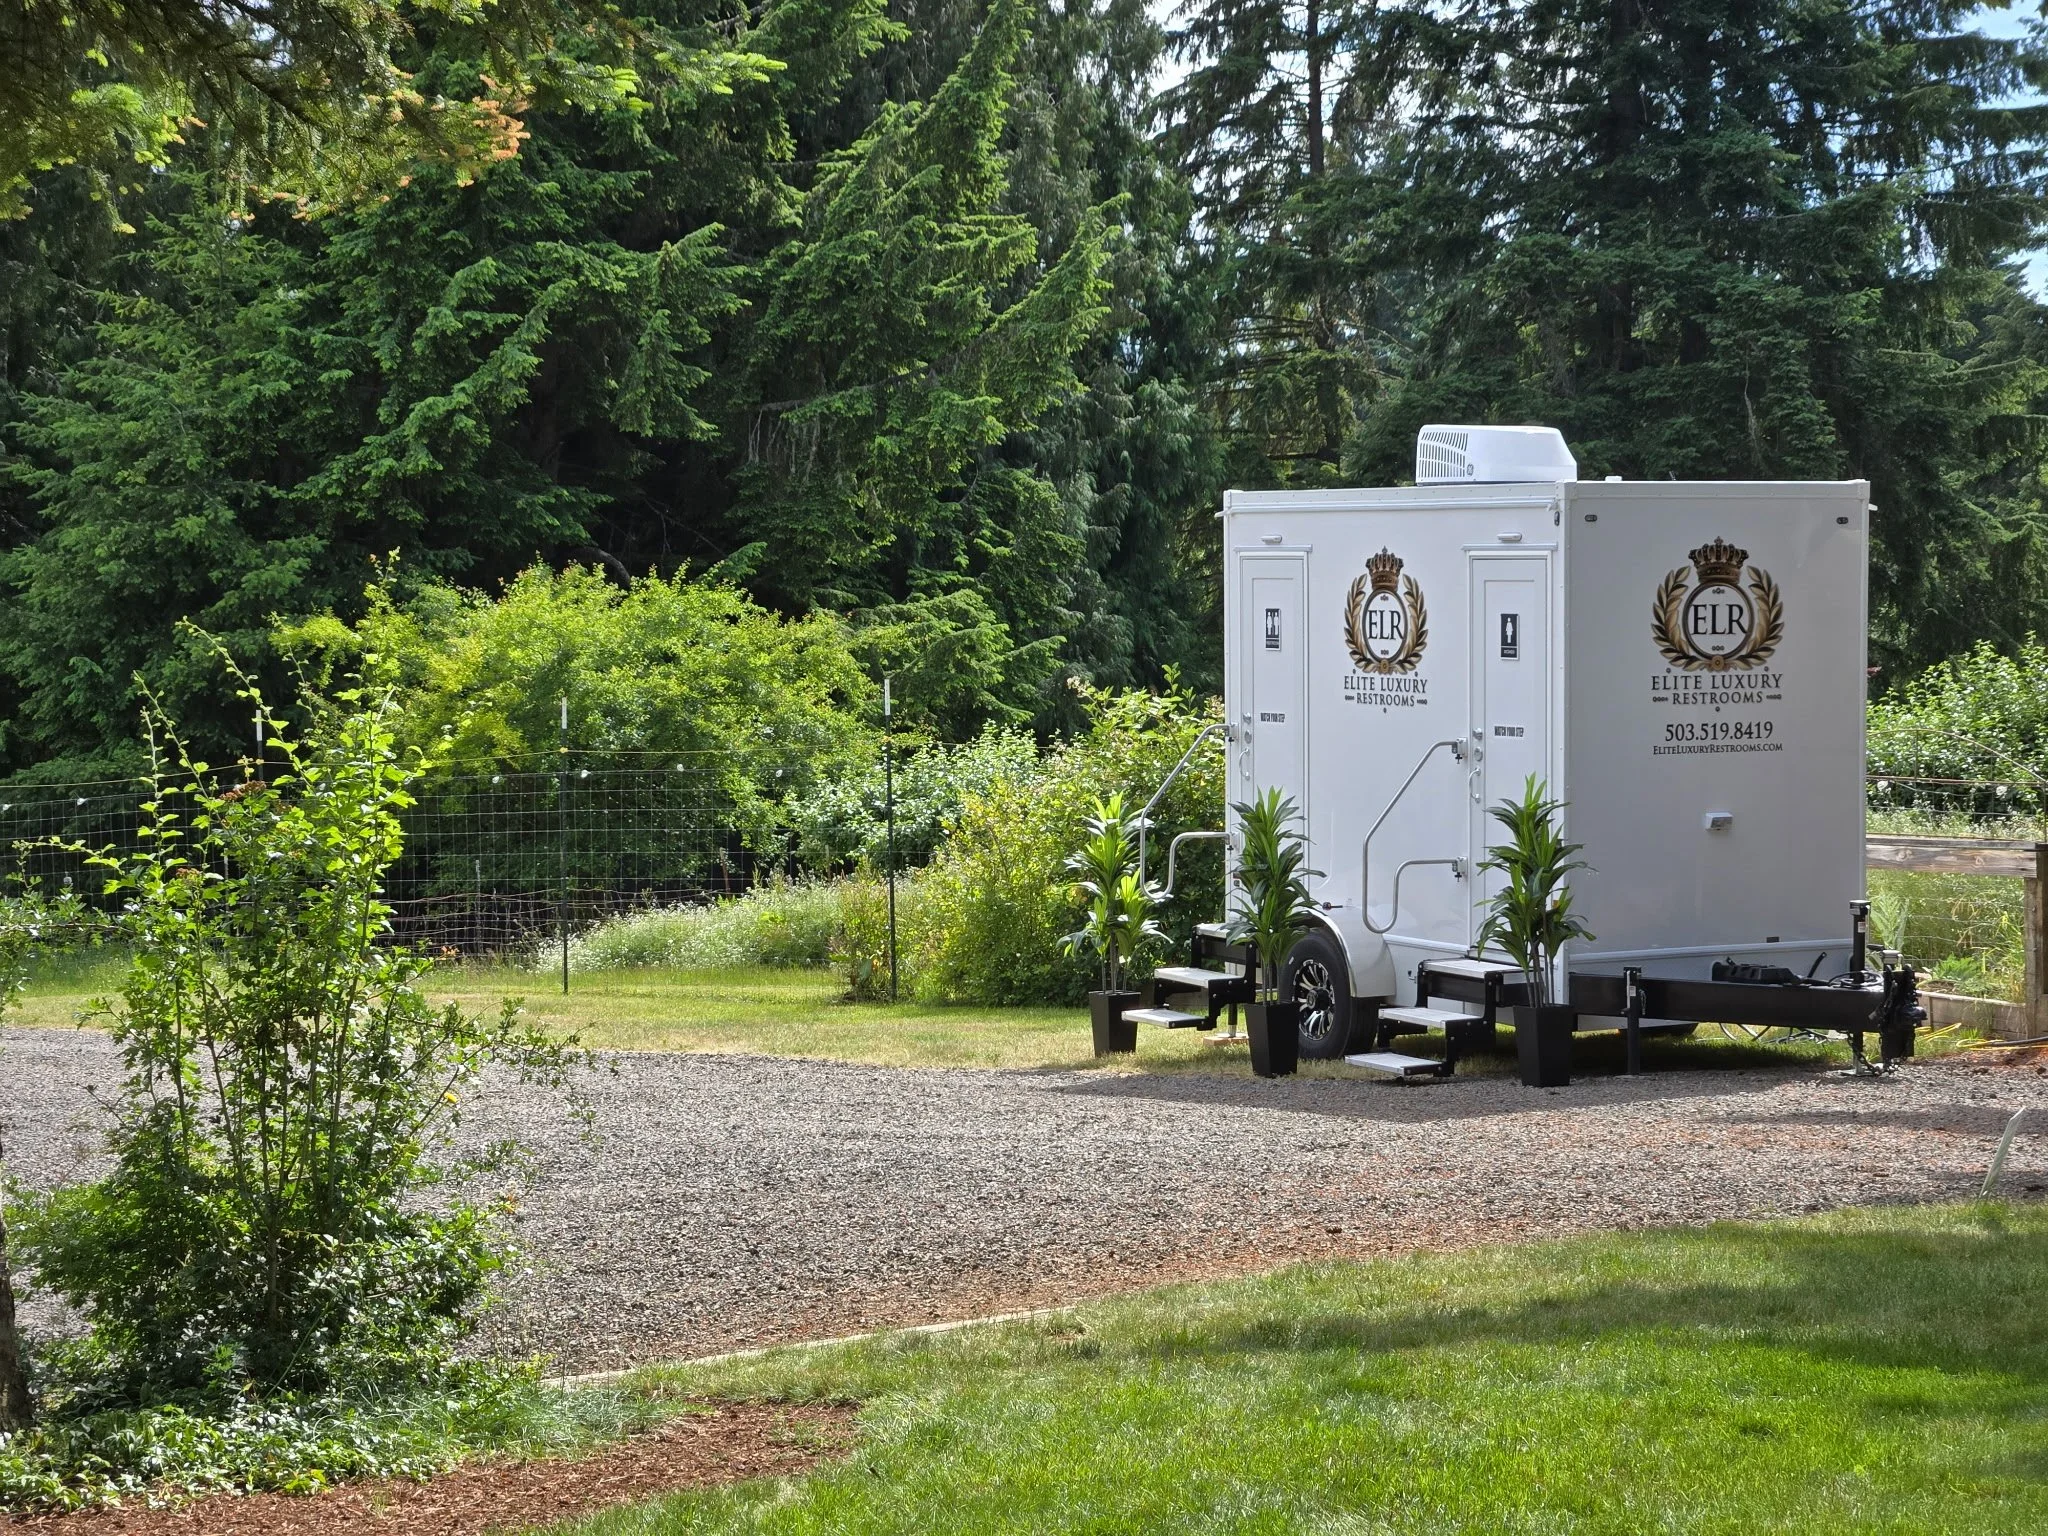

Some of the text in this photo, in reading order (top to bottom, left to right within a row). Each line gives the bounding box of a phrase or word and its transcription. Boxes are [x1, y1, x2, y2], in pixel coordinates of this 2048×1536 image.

[1368, 610, 1405, 640] ELR
[1691, 603, 1748, 635] ELR
[1344, 676, 1428, 693] ELITE LUXURY
[1651, 674, 1783, 691] ELITE LUXURY
[1356, 692, 1415, 707] RESTROOMS
[1672, 691, 1763, 705] RESTROOMS
[1665, 721, 1773, 742] 503.519.8419
